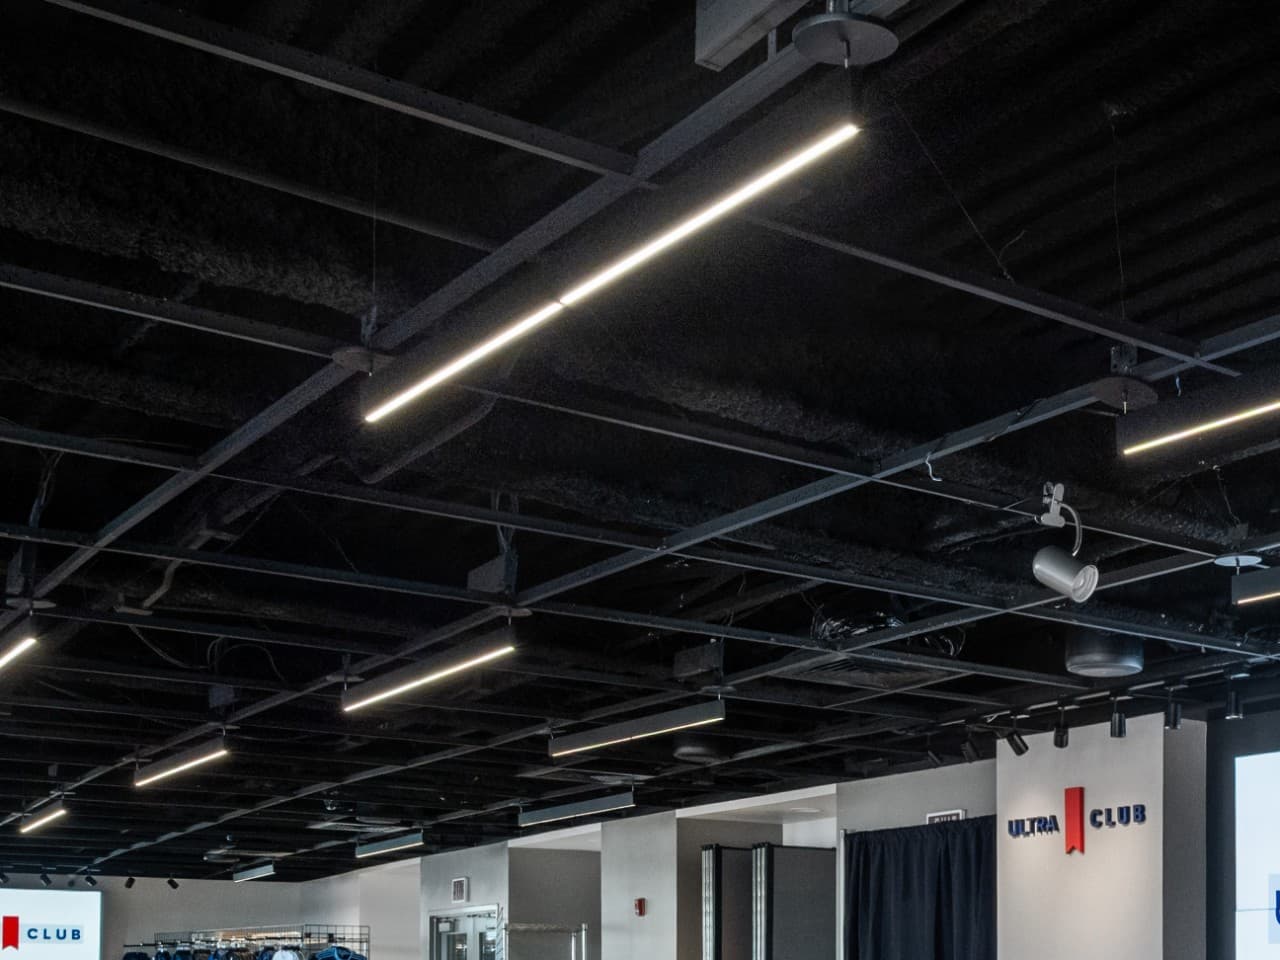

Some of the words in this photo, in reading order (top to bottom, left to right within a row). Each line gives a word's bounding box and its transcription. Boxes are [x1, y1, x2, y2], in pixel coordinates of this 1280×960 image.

[1008, 815, 1060, 838] ULTRA
[1090, 804, 1146, 828] CLUB
[27, 928, 81, 940] CLUB
